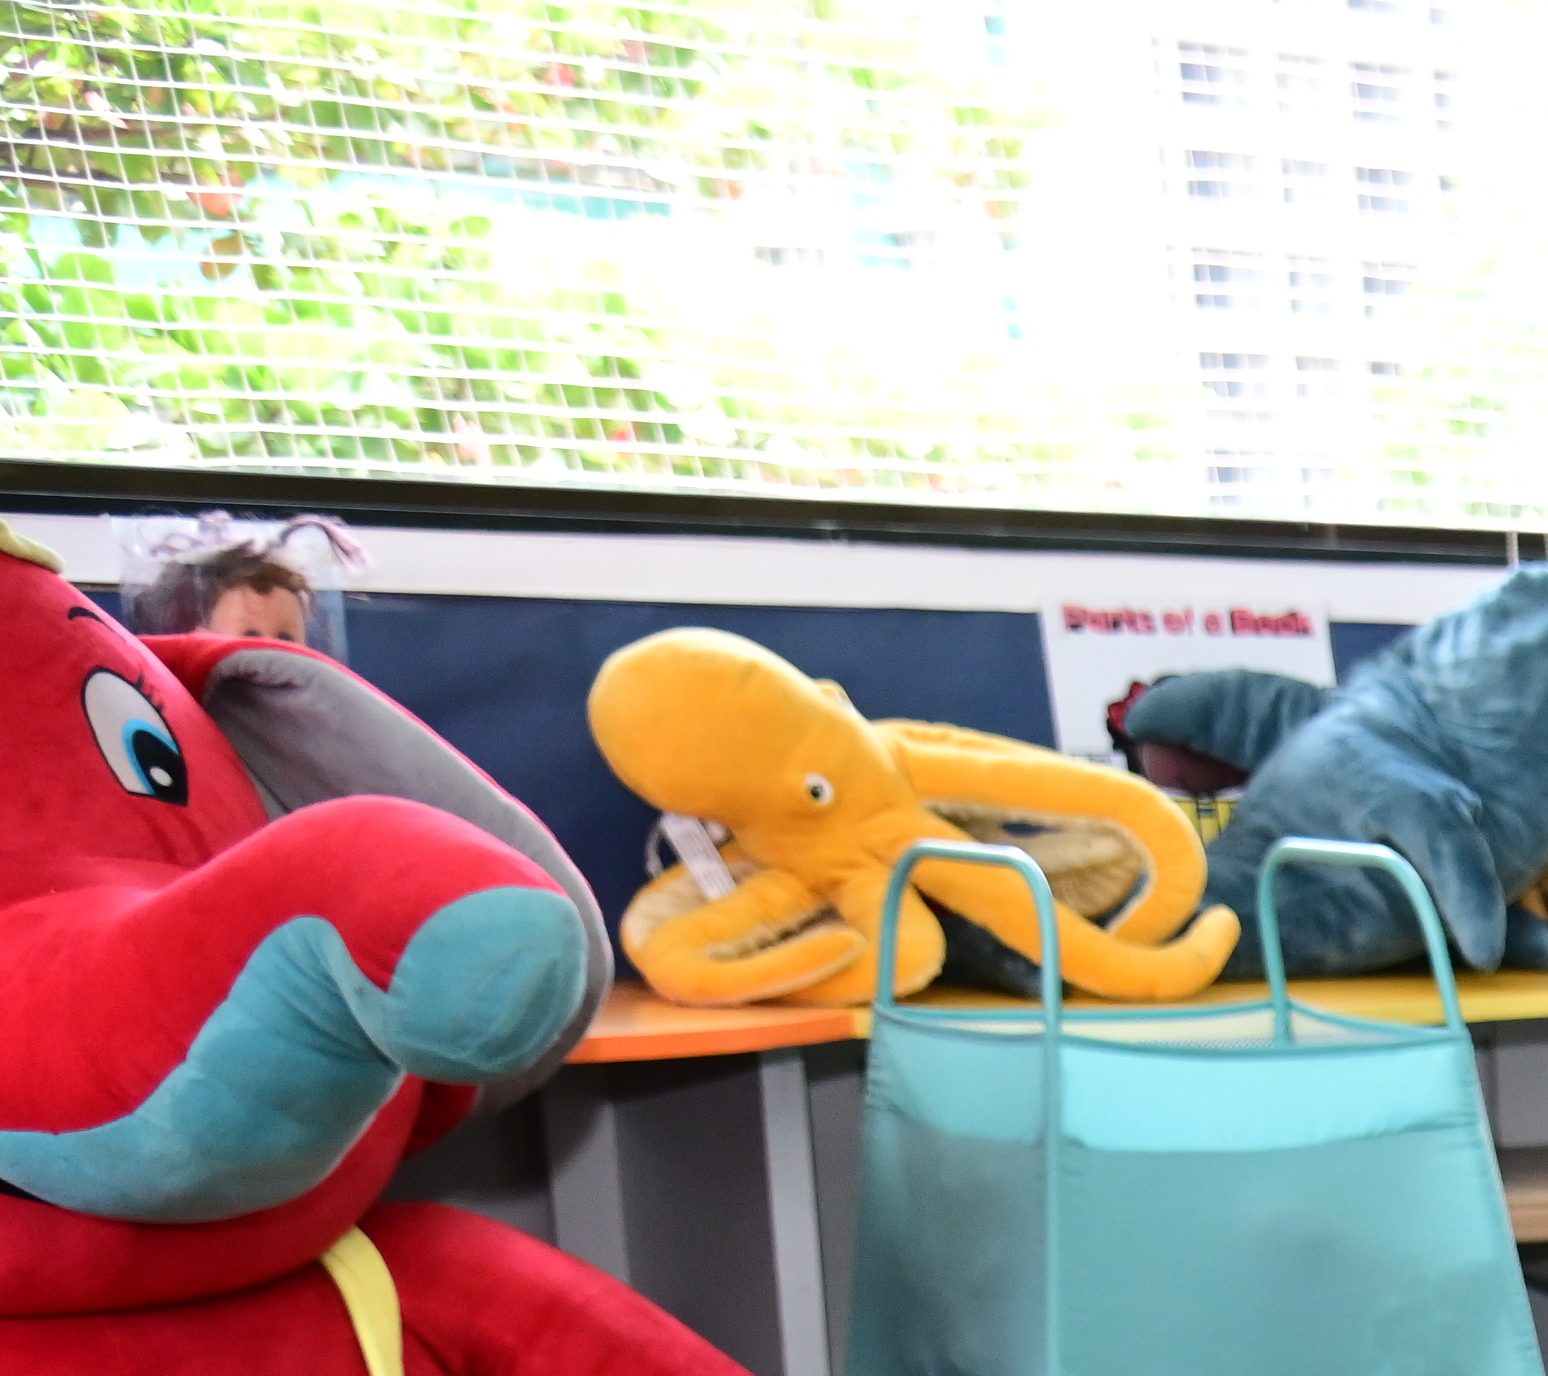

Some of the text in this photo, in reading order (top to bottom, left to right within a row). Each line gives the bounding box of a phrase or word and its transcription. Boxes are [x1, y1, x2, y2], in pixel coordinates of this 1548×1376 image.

[1062, 604, 1315, 637] Parts of a Book
